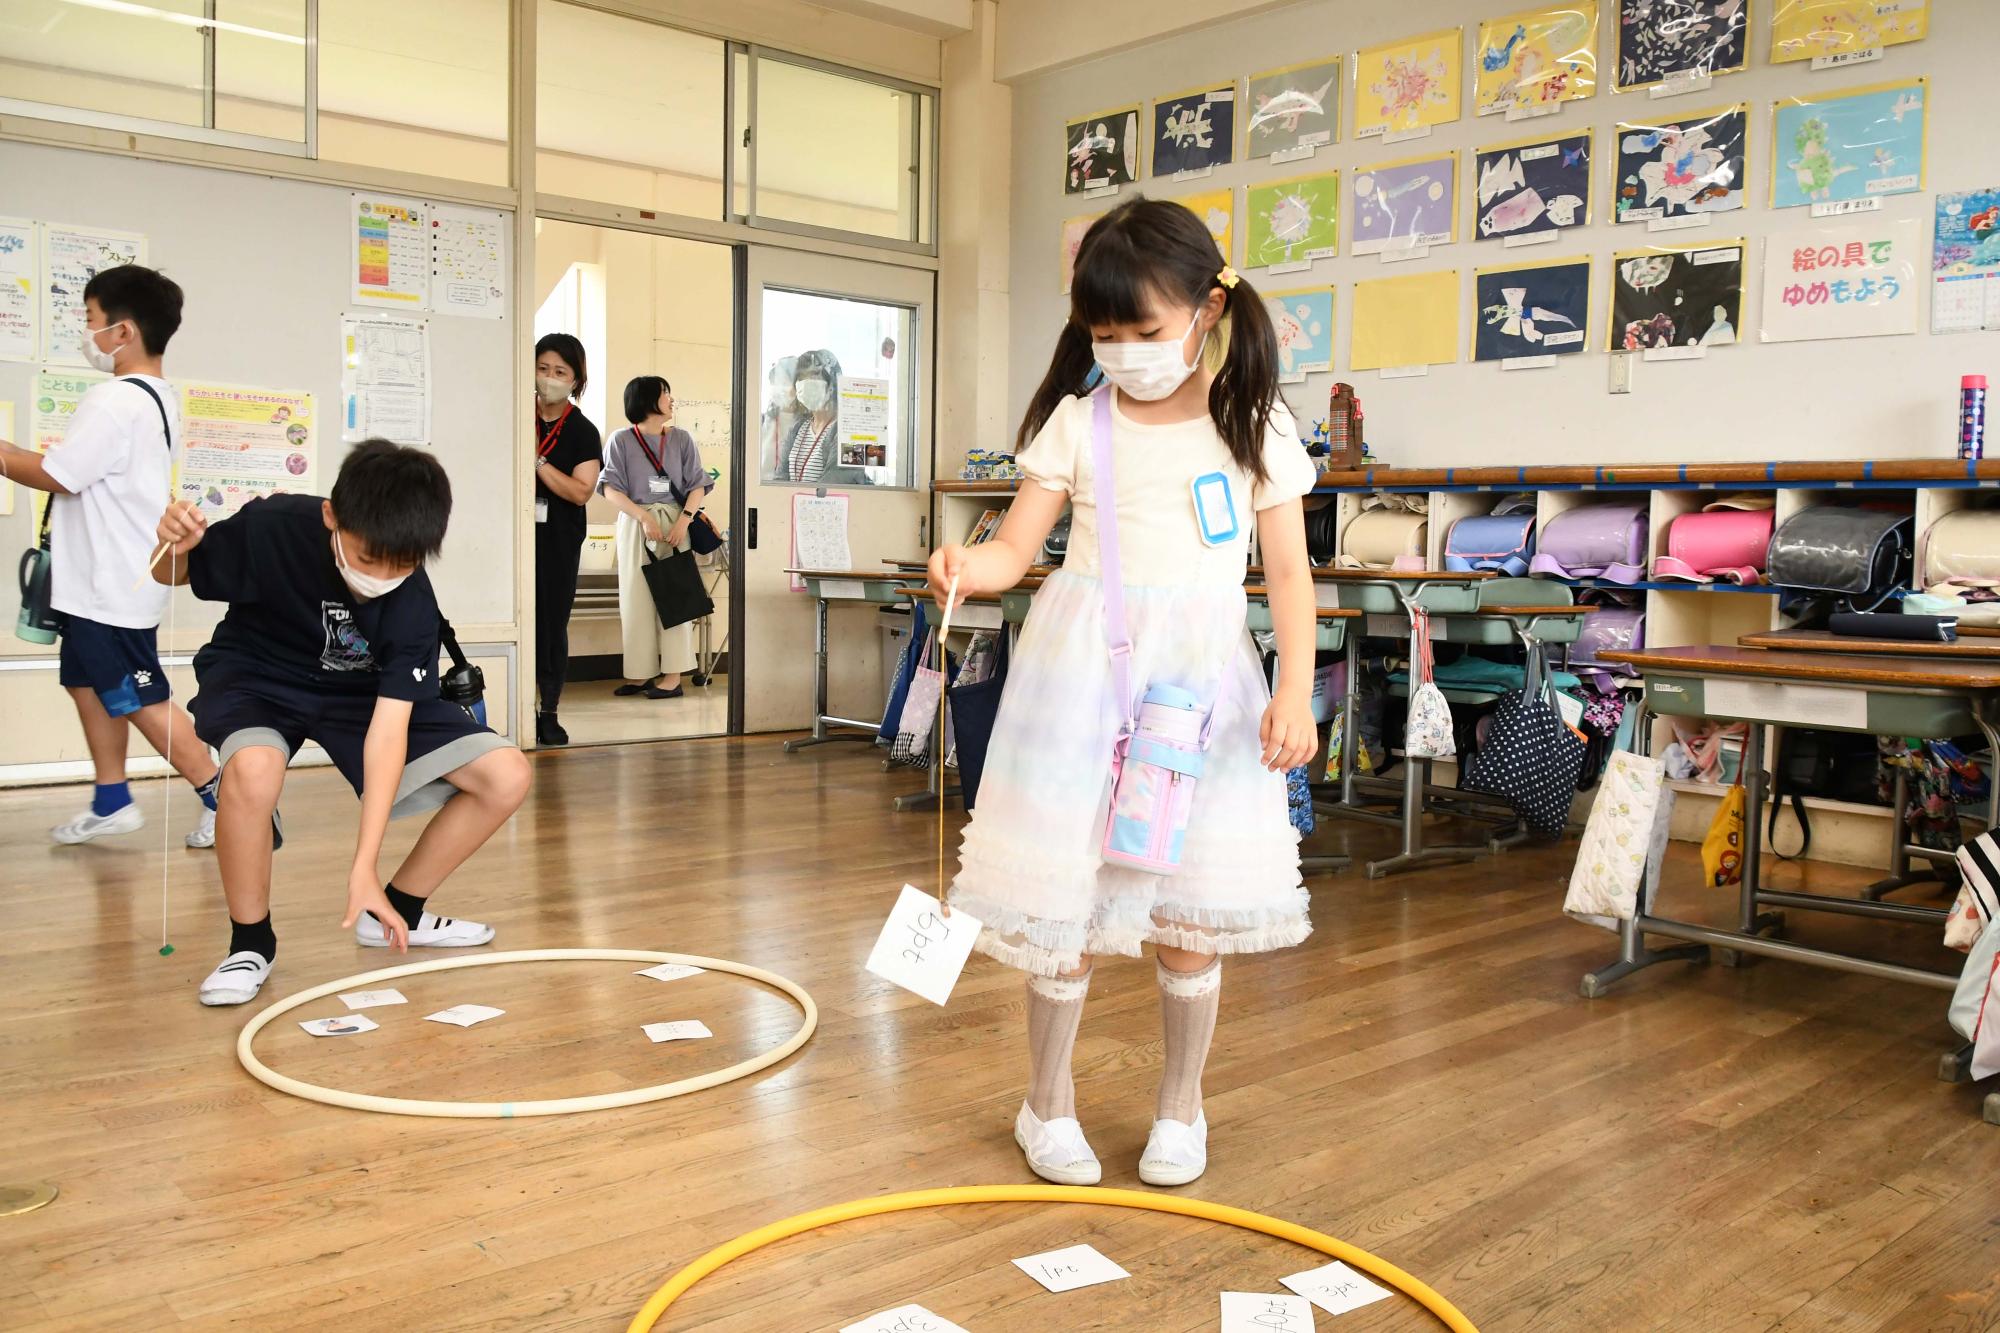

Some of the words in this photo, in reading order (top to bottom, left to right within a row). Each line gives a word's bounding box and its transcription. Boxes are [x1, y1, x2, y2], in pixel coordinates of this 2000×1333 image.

[1792, 240, 1893, 272] 絵の具で
[1782, 276, 1900, 306] ゆめもよう
[902, 911, 950, 964] 5pt
[1041, 1264, 1079, 1280] 1pt
[1319, 1281, 1358, 1298] 3pt
